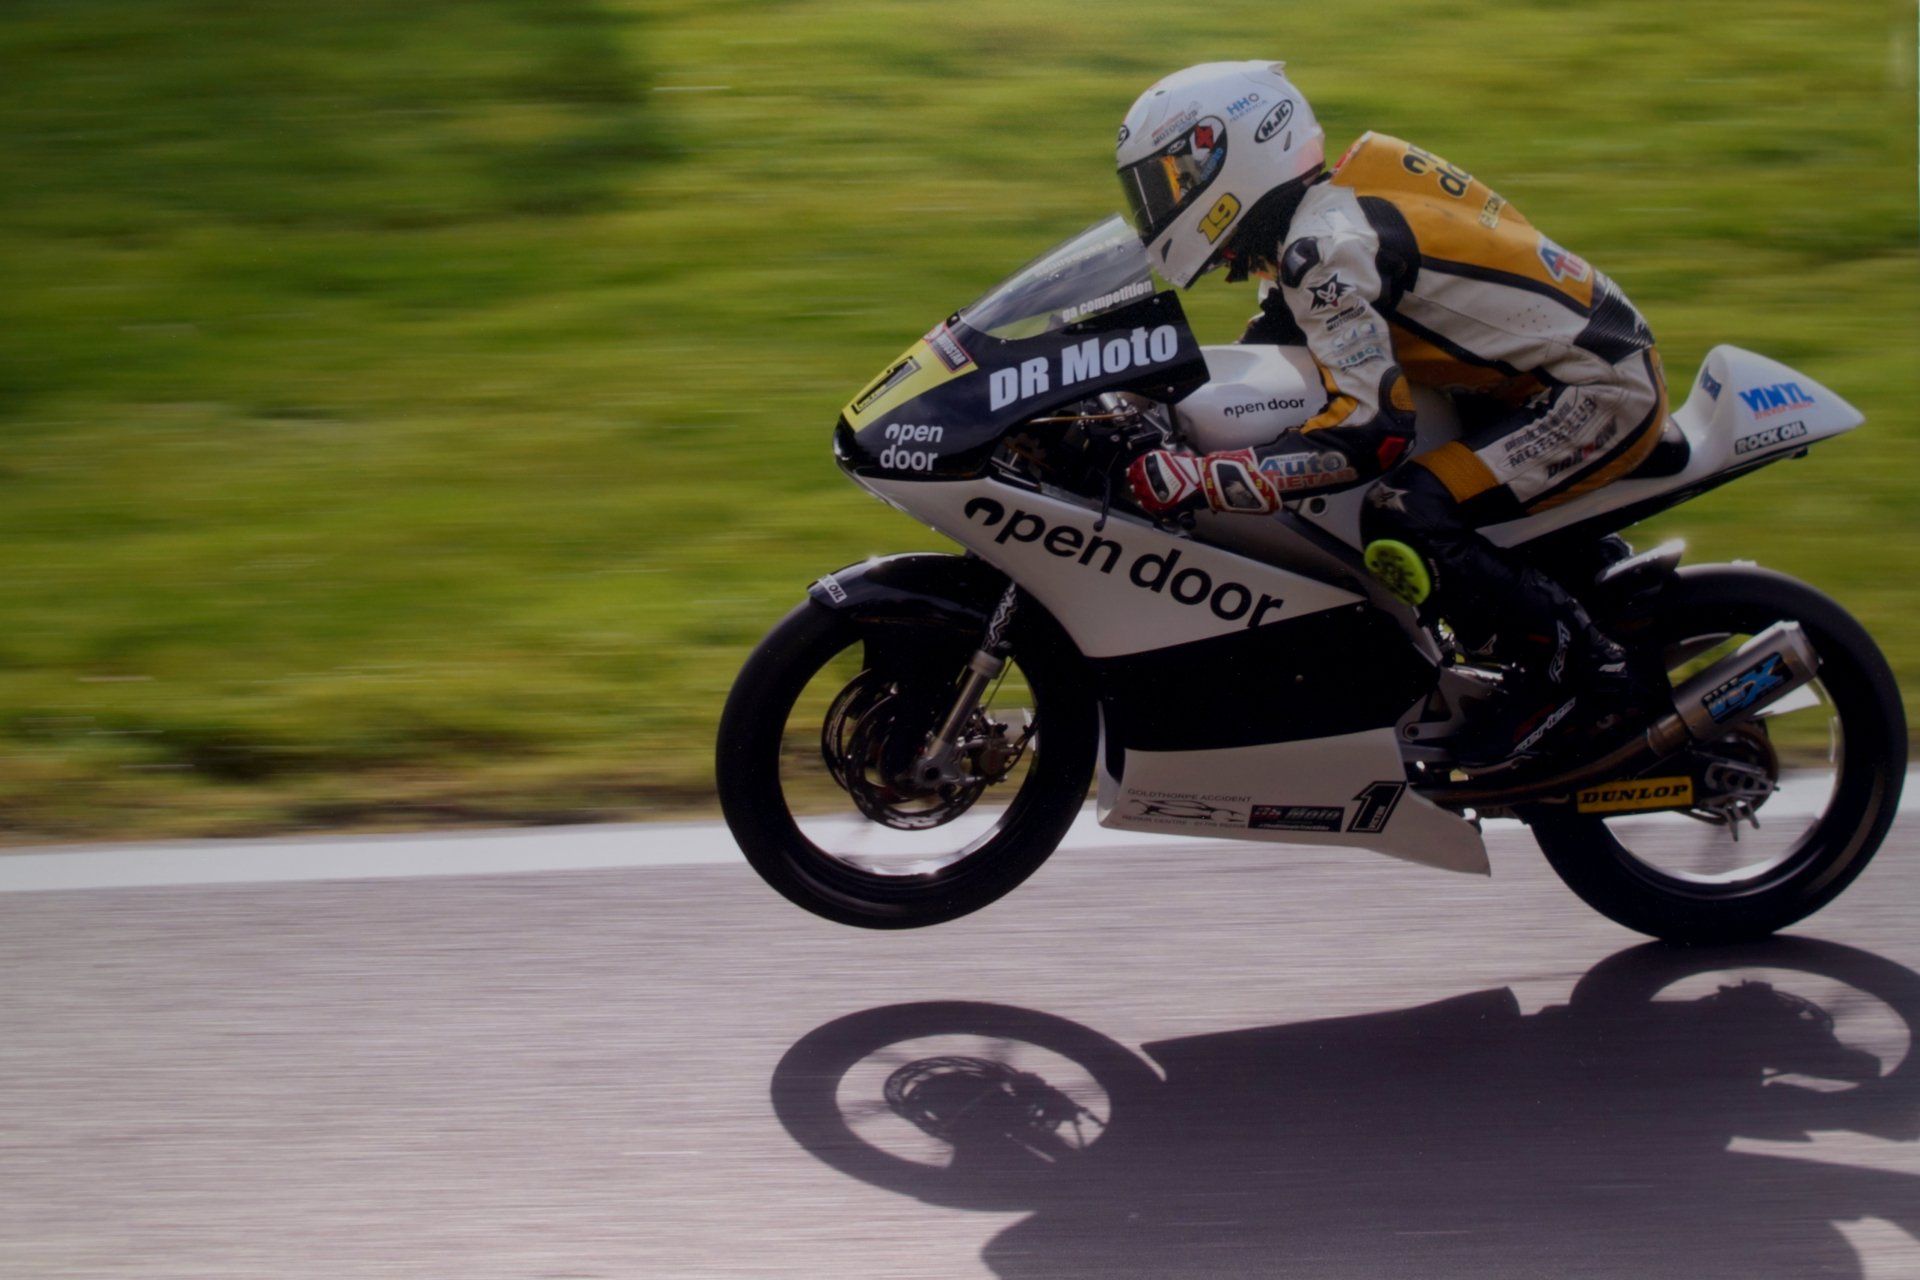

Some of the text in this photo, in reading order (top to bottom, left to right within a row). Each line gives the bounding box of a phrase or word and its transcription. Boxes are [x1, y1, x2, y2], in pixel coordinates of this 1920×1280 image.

[1259, 102, 1292, 139] HJC
[1197, 192, 1242, 245] 19
[1079, 280, 1152, 314] competition
[989, 325, 1178, 412] DR Moto
[1223, 397, 1306, 419] open door
[1738, 382, 1816, 412] VINYL
[880, 424, 944, 472] open door
[1736, 421, 1806, 454] ROCK OIL
[964, 497, 1284, 627] open door
[1127, 788, 1252, 803] GOLDTHORPE ACCIDENT
[1346, 781, 1407, 833] 1
[1581, 784, 1690, 805] DUNLOP
